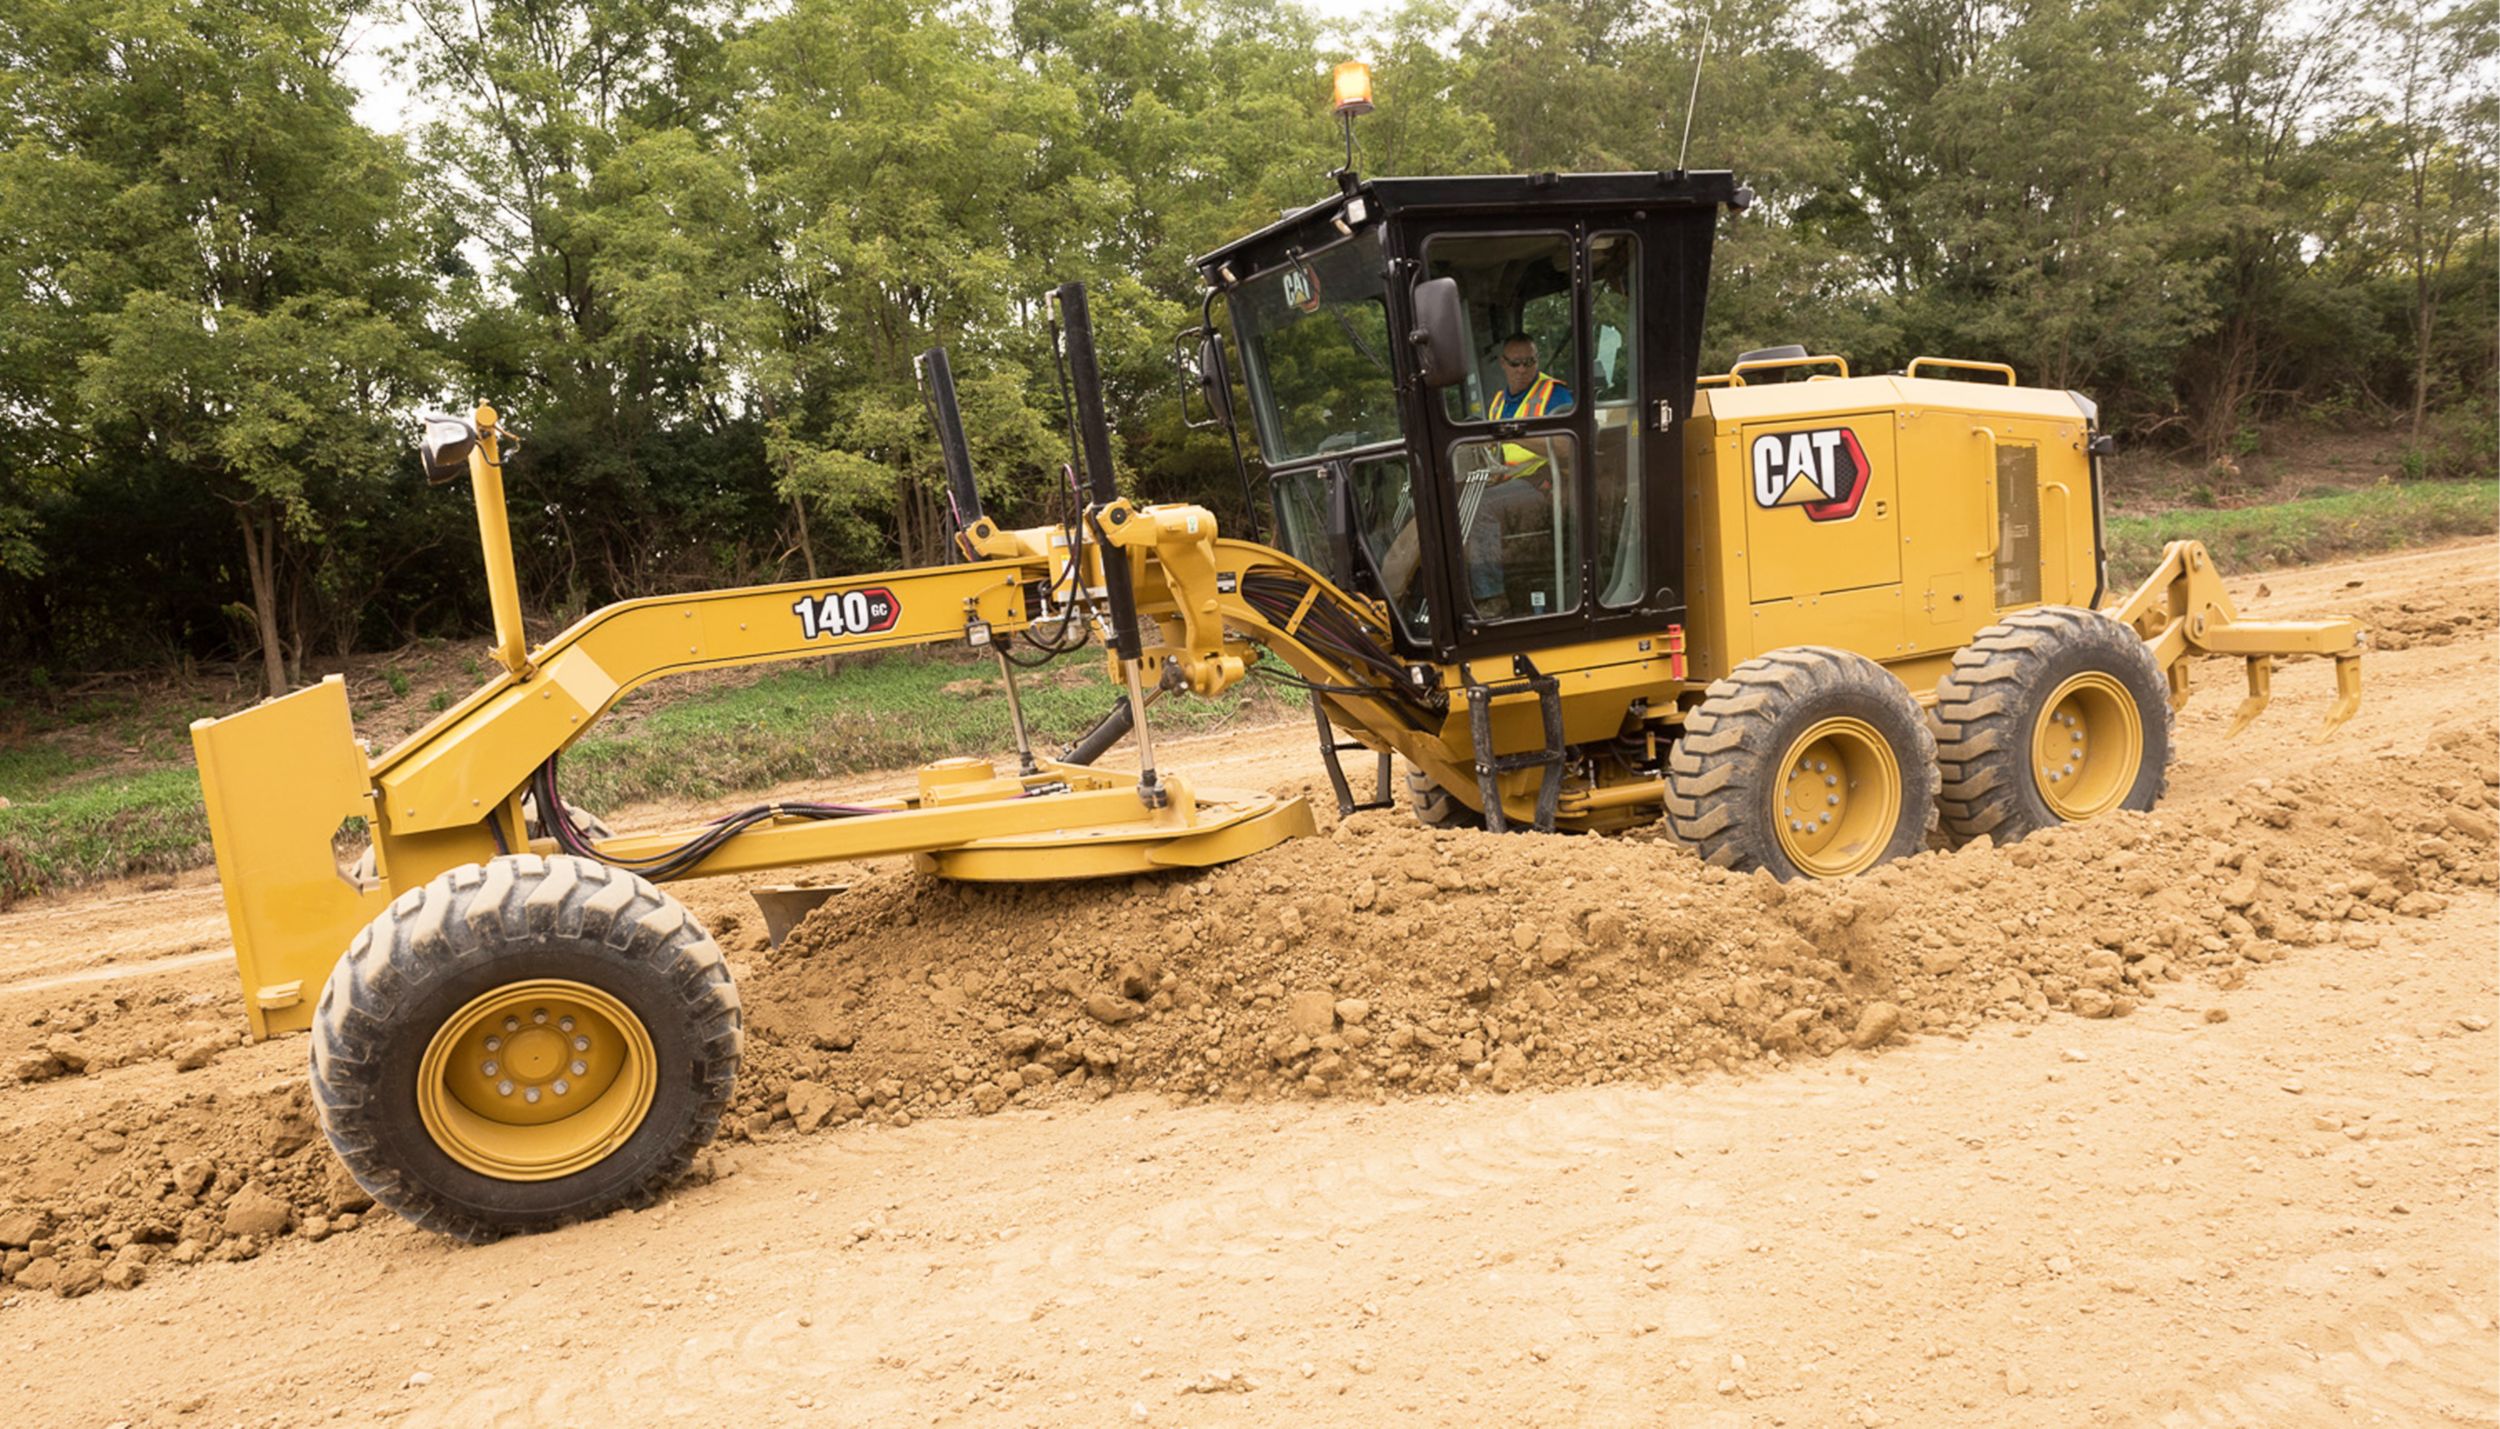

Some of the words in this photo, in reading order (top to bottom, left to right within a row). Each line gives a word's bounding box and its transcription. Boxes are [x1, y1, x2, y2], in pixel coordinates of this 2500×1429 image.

[1753, 429, 1842, 507] CAT
[794, 591, 869, 638] 140
[871, 603, 888, 617] GC
